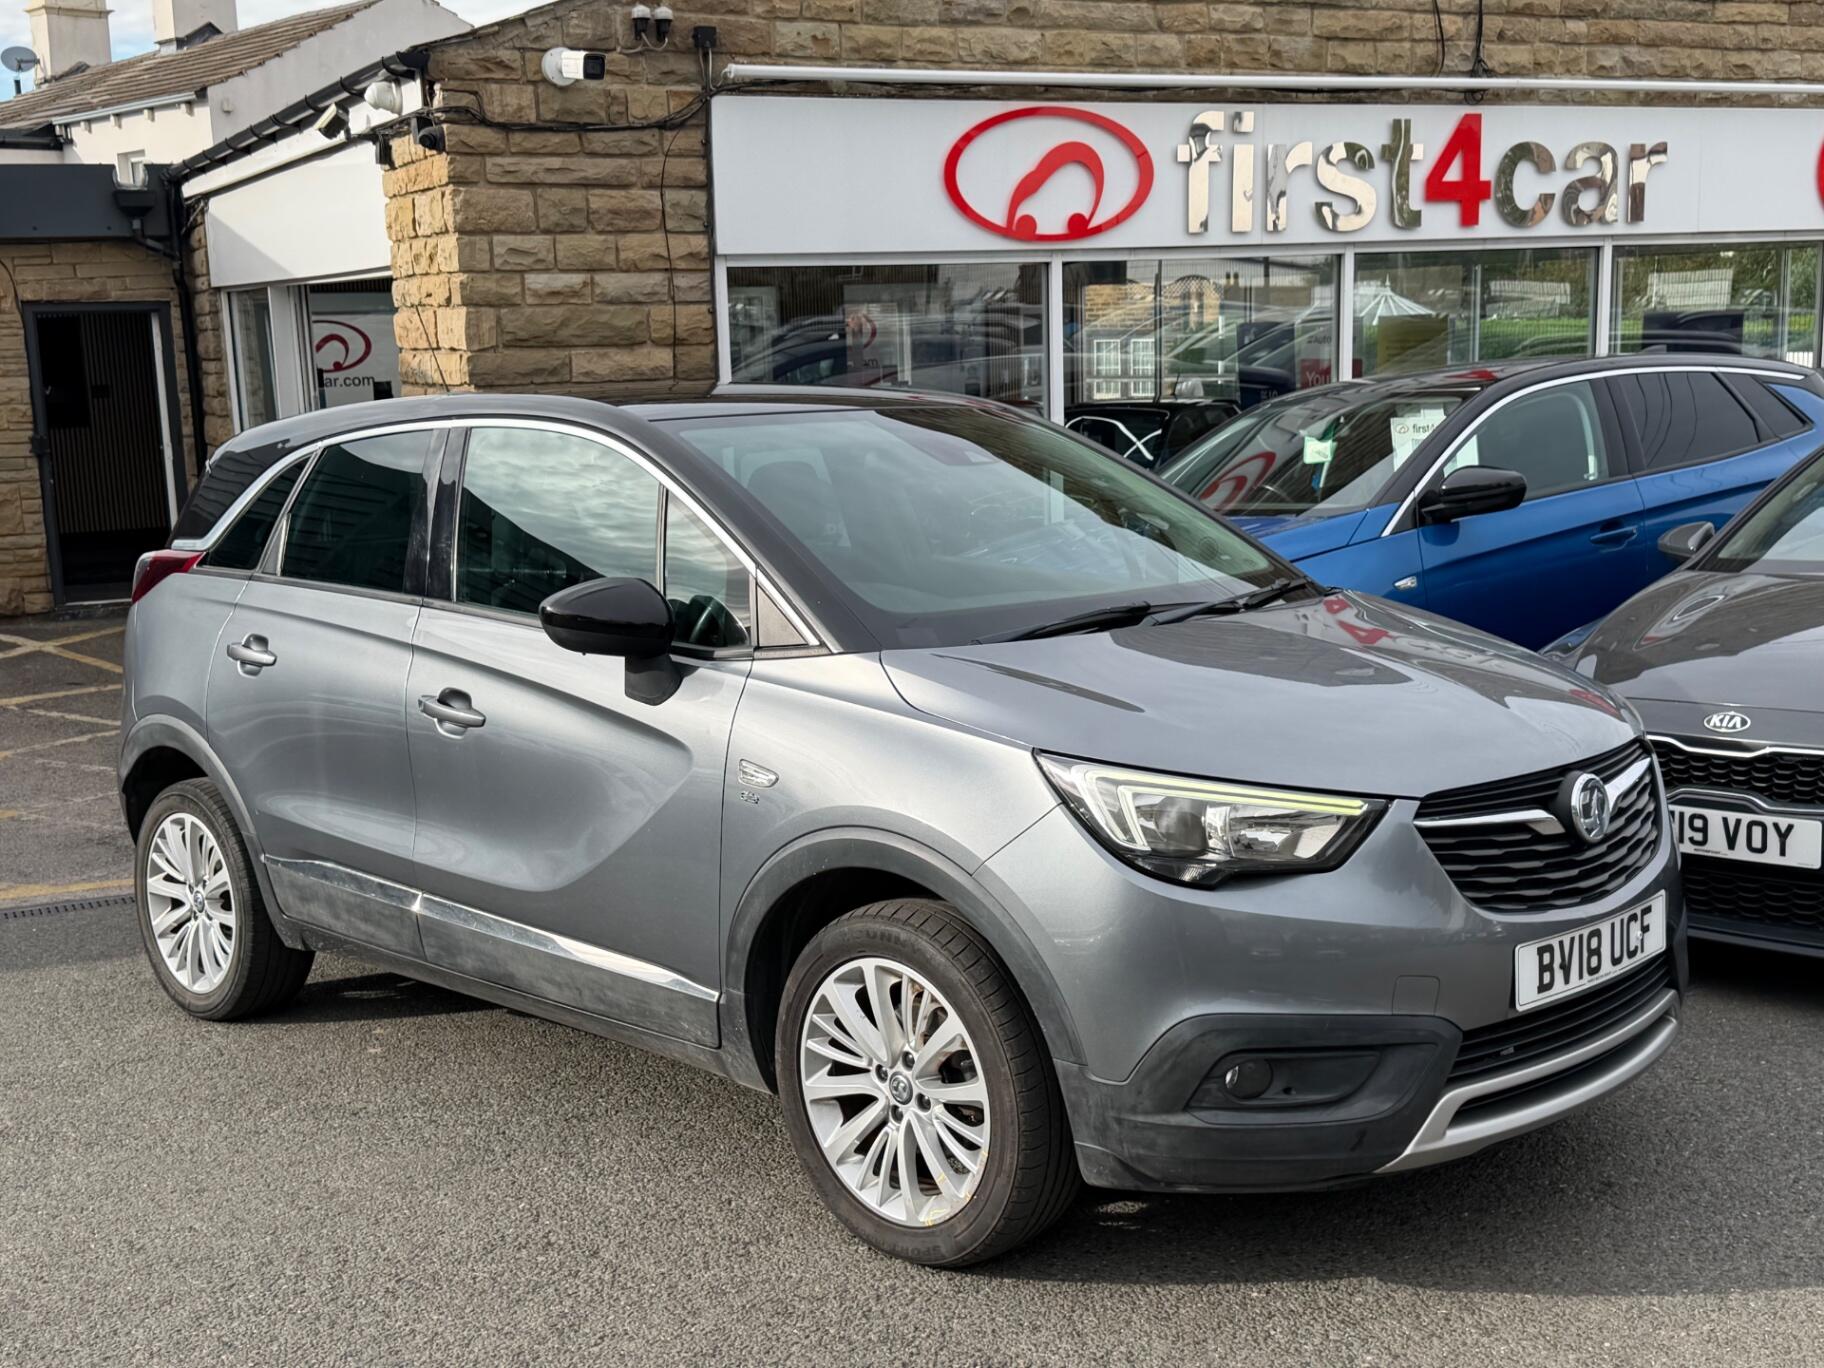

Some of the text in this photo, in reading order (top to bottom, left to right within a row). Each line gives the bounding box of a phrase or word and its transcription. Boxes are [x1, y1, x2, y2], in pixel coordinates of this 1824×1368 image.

[1176, 110, 1669, 234] first4car
[1709, 714, 1742, 729] KIA
[1670, 810, 1795, 858] 19 VOY
[1536, 904, 1653, 995] BV18 UCF
